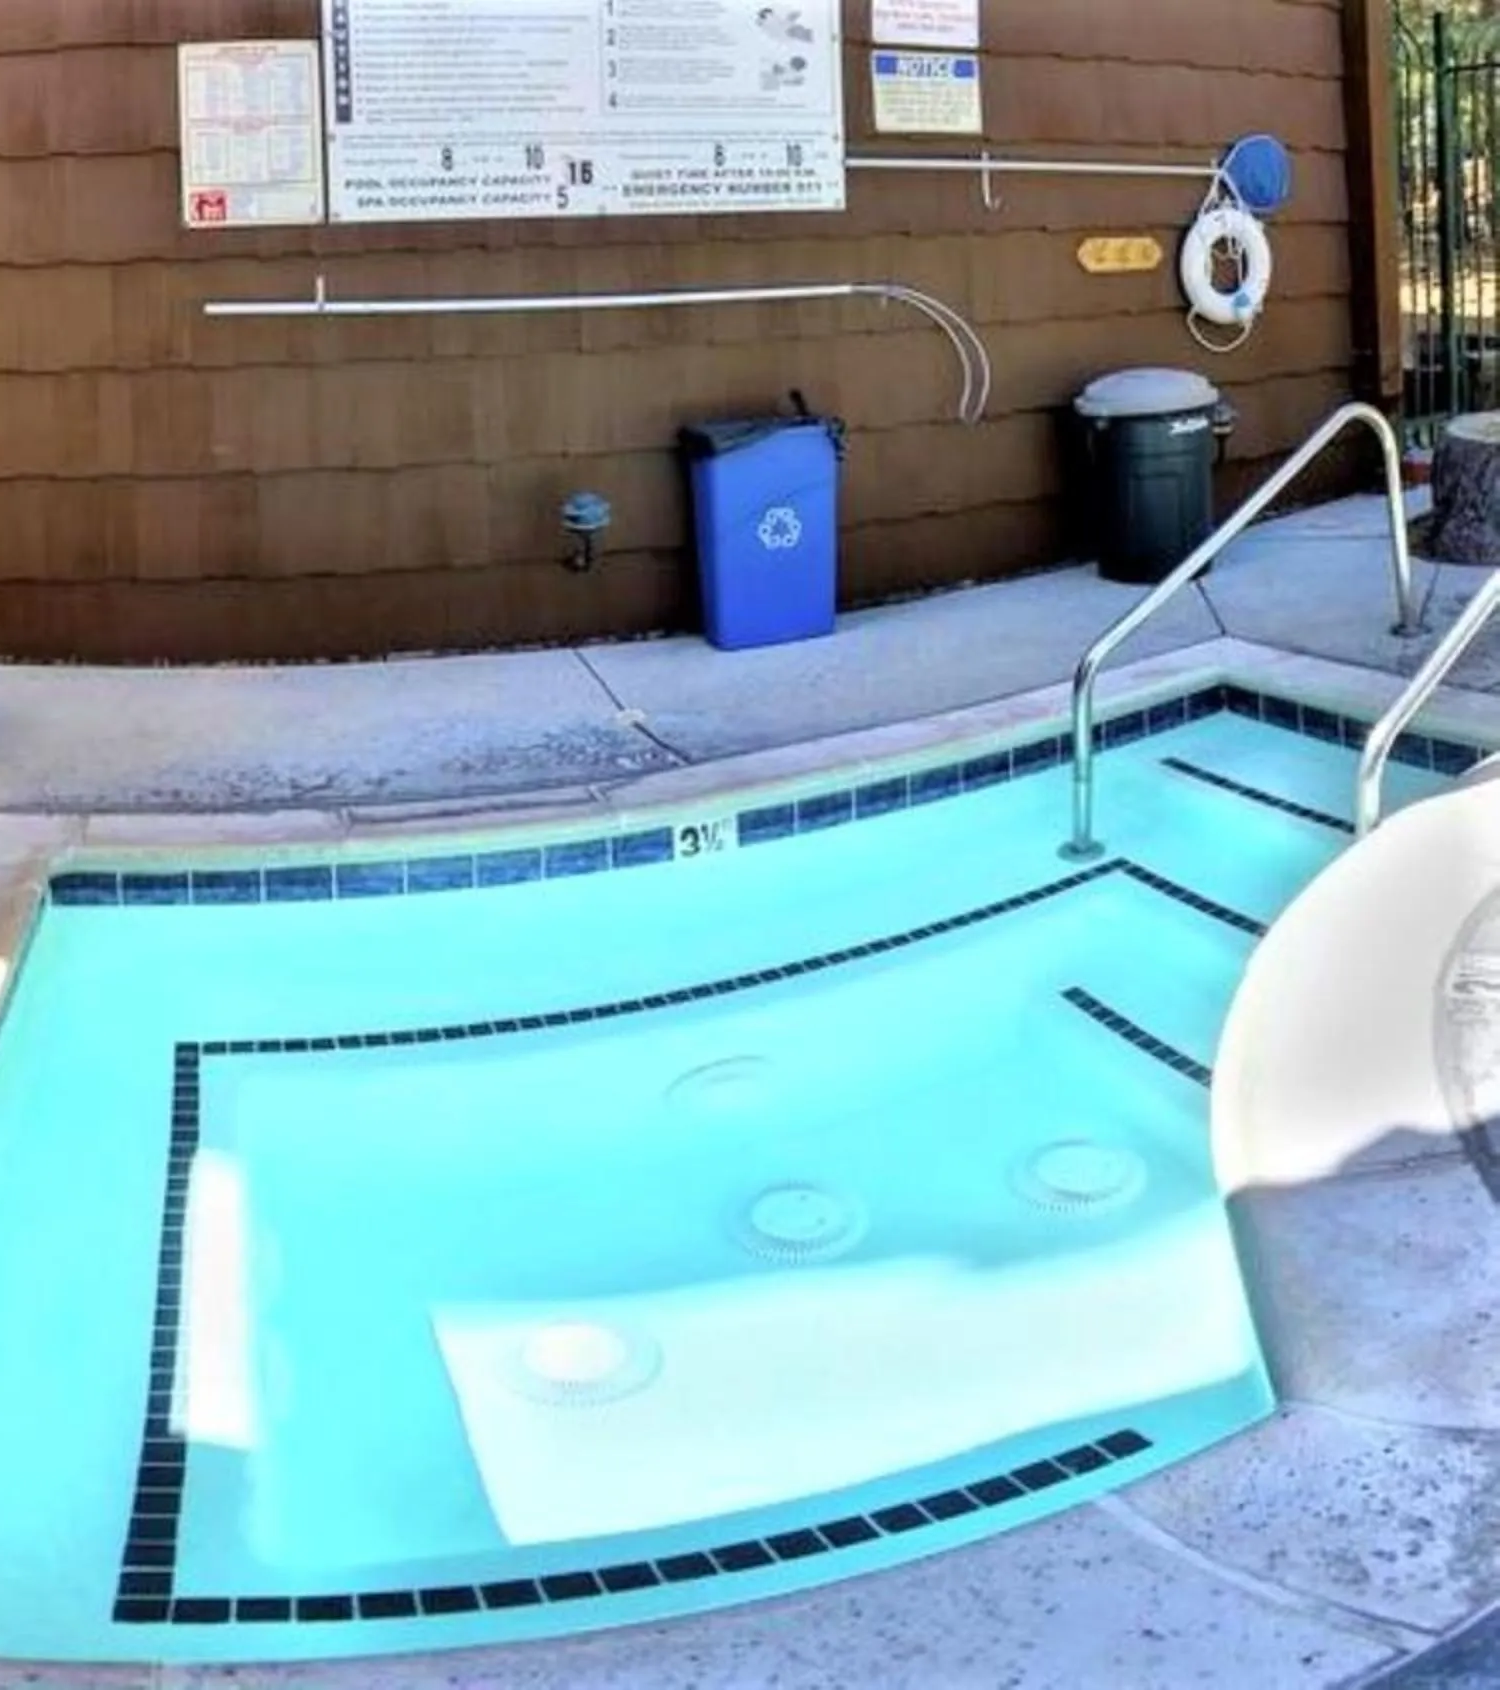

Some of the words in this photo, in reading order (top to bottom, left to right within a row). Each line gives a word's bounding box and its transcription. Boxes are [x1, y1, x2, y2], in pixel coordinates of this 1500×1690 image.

[898, 57, 951, 78] NOTICE
[440, 147, 453, 171] 8
[525, 145, 545, 170] 10
[344, 177, 382, 190] POOL
[389, 174, 477, 189] OCCUPANCY
[482, 173, 551, 186] CAPACITY
[569, 160, 593, 185] 16
[357, 194, 384, 208] SPA
[389, 191, 477, 207] OCCUPANCY
[482, 190, 551, 204] CAPACITY
[556, 185, 570, 210] 5
[621, 182, 722, 198] EMERGENCY
[728, 181, 791, 196] NUMBER
